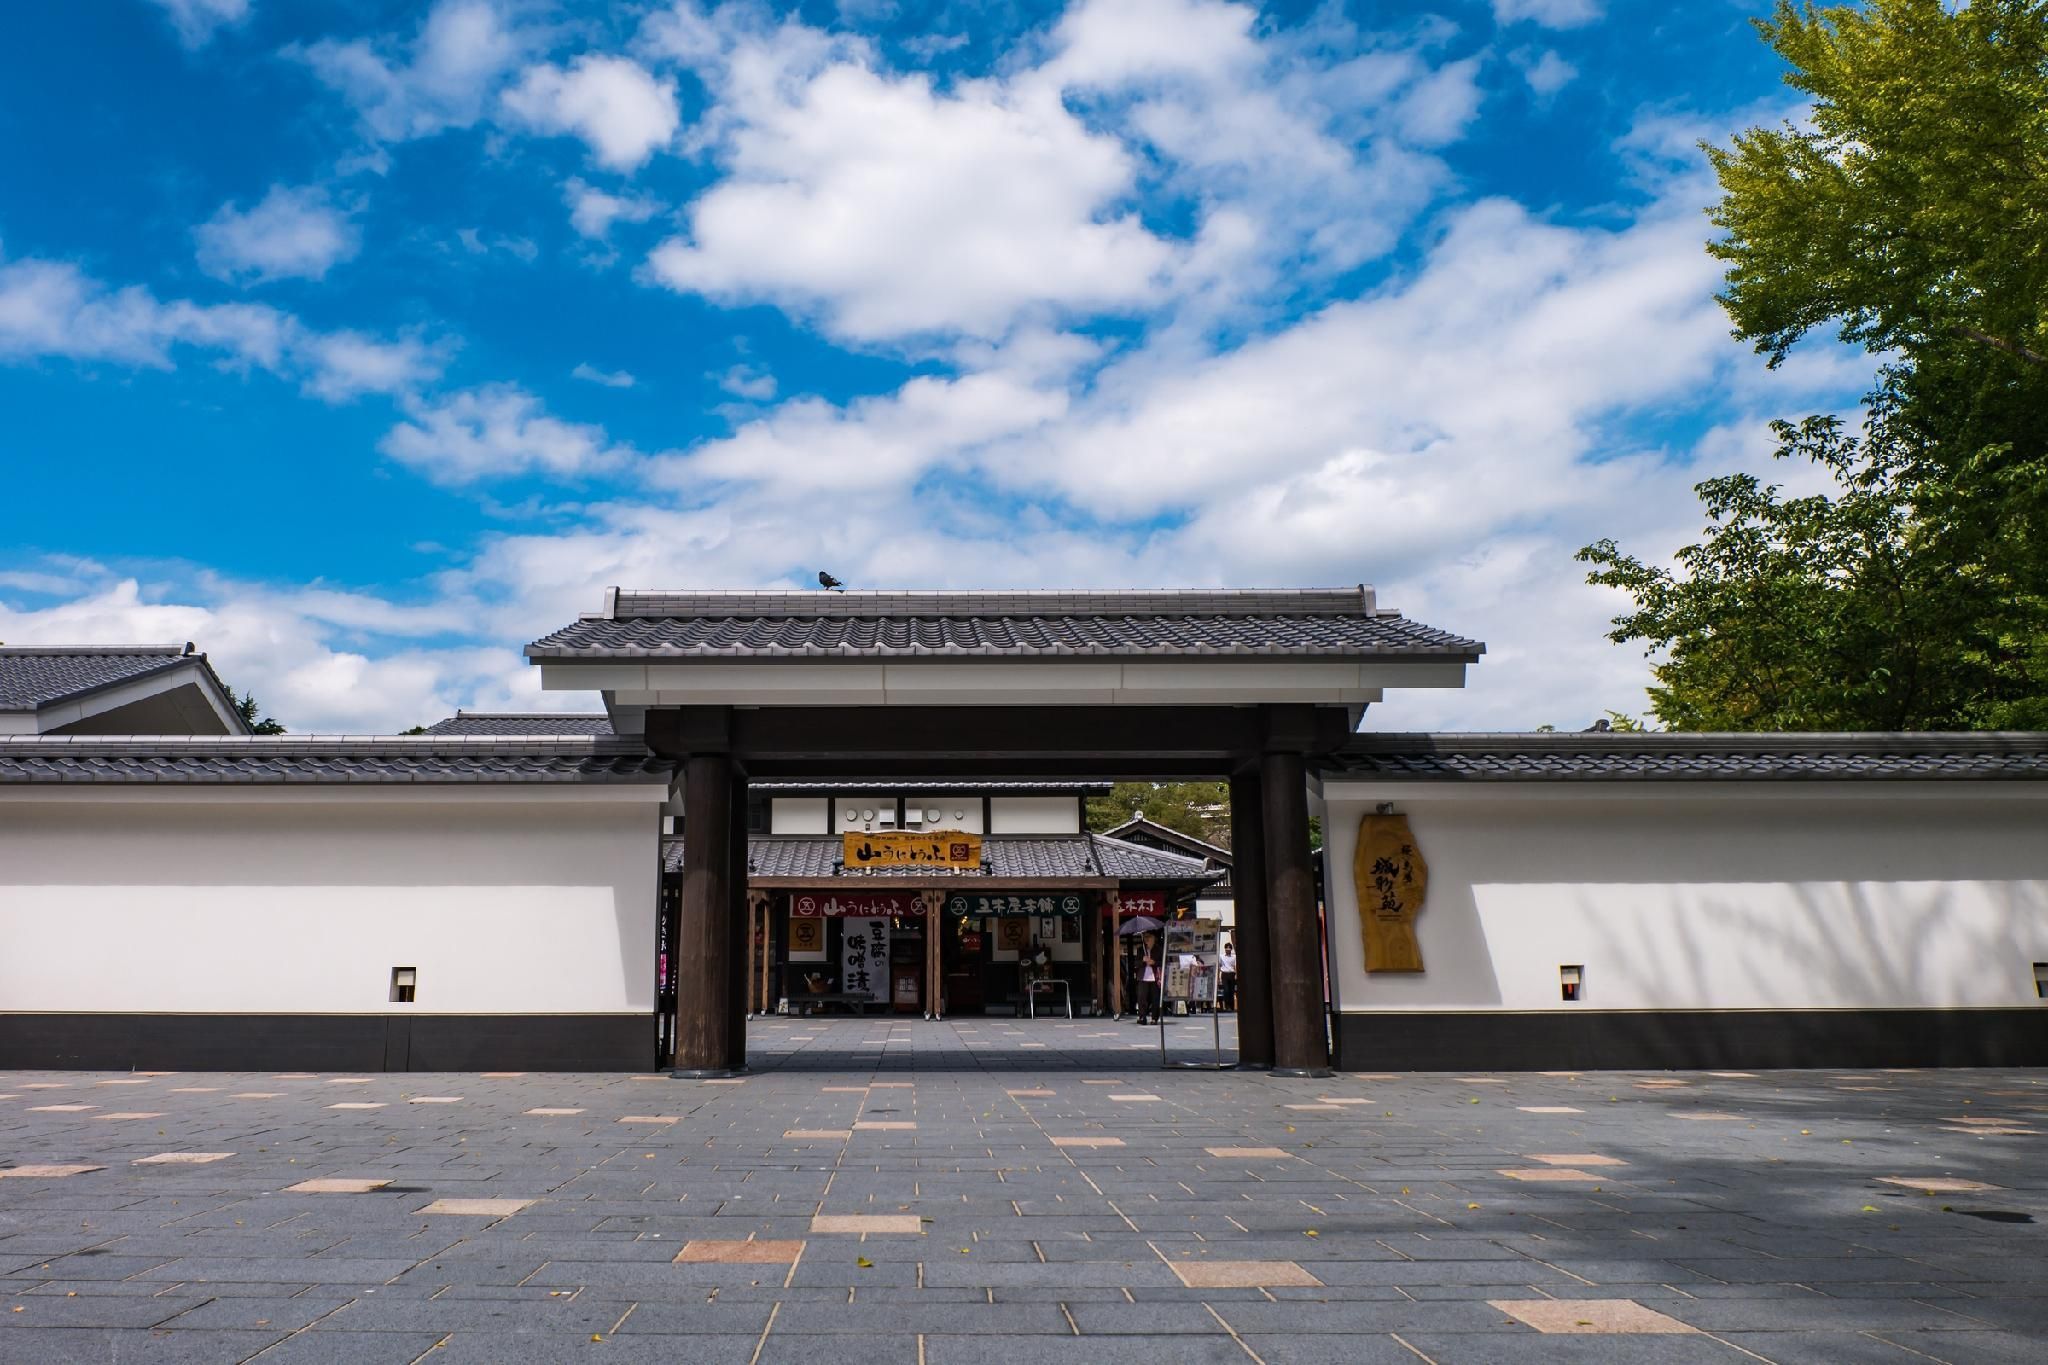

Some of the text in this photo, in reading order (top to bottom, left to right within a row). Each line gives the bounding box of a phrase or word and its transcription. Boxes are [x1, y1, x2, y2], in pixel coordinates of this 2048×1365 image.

[857, 842, 945, 861] 山うにとうふ
[823, 897, 904, 915] 山うにとうふ
[869, 920, 887, 967] 豆腐の
[847, 933, 871, 992] 味噌漬
